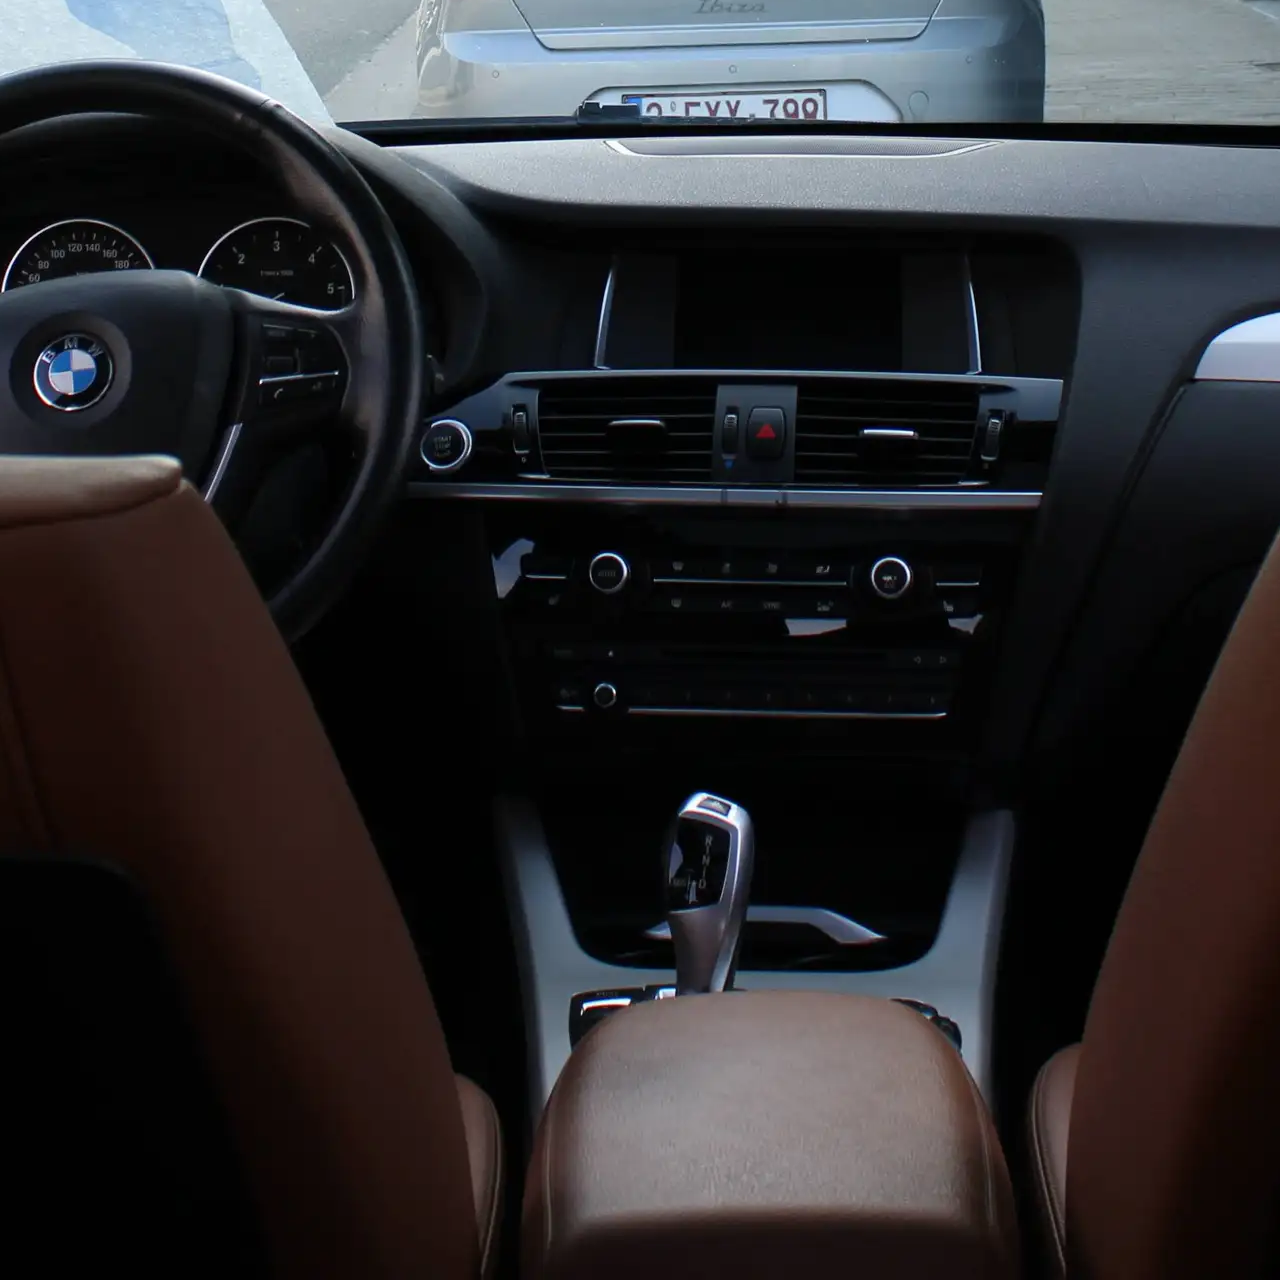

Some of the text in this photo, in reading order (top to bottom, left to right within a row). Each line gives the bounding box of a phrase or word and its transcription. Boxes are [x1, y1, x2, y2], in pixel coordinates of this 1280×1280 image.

[68, 243, 83, 253] 120
[84, 243, 101, 253] 140
[273, 240, 280, 252] 3
[50, 248, 66, 259] 100
[102, 248, 118, 258] 160
[37, 259, 50, 270] 80
[114, 260, 129, 269] 180
[238, 253, 246, 265] 2
[308, 253, 316, 265] 4
[28, 274, 41, 283] 60
[327, 282, 335, 295] 5
